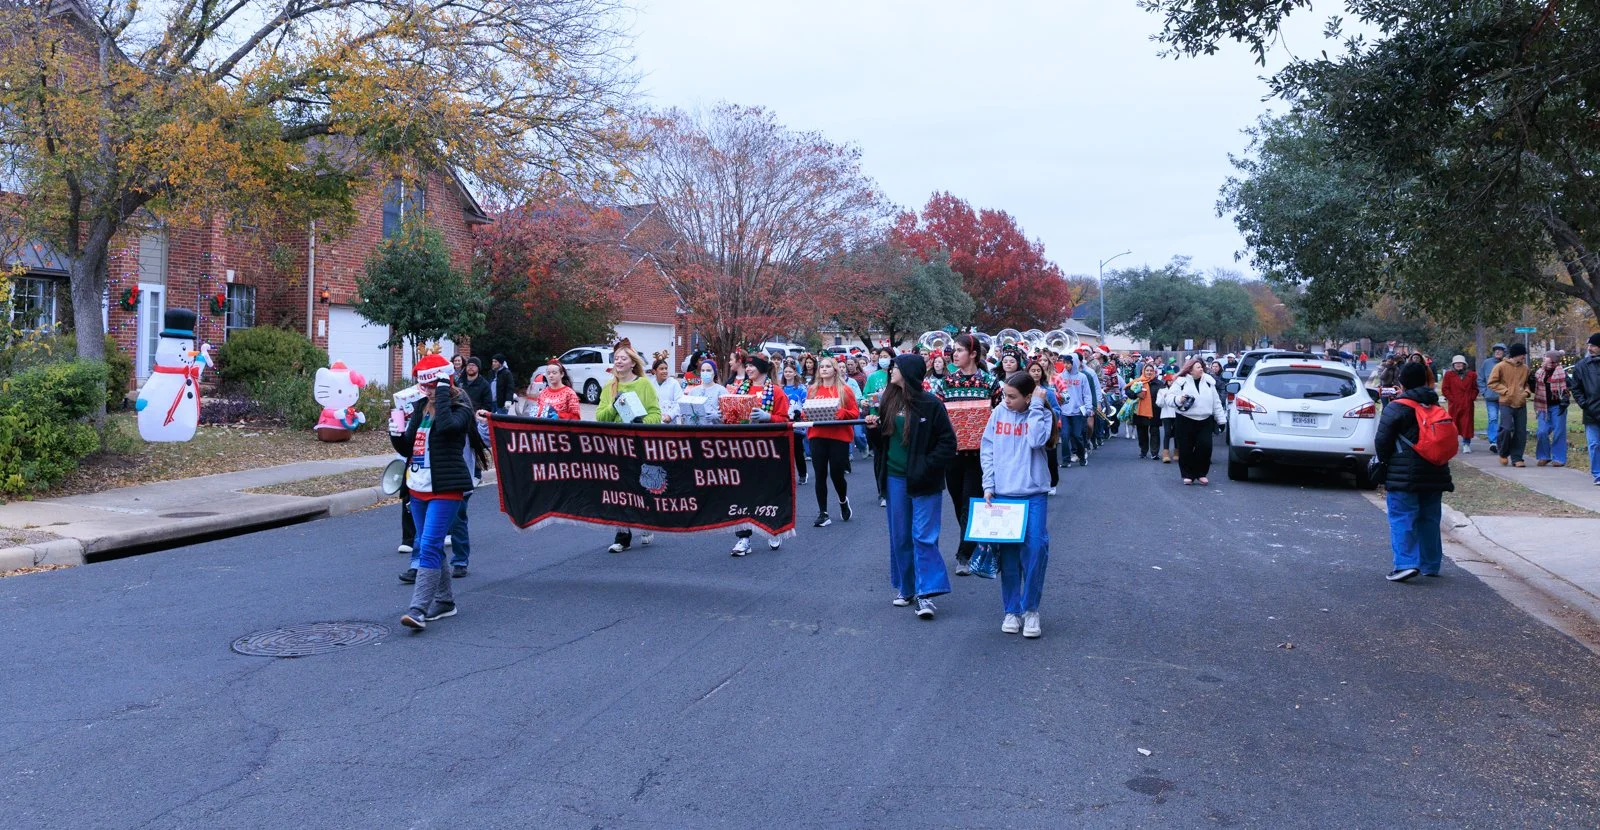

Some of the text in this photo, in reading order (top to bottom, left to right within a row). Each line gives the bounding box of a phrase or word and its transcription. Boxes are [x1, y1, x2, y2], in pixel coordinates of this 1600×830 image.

[507, 432, 781, 460] JAMES BOWIE HIGH SCHOOL
[532, 462, 741, 486] MARCHING BAND
[601, 490, 698, 512] AUSTIN, TEXAS
[728, 504, 779, 517] Est. 1988
